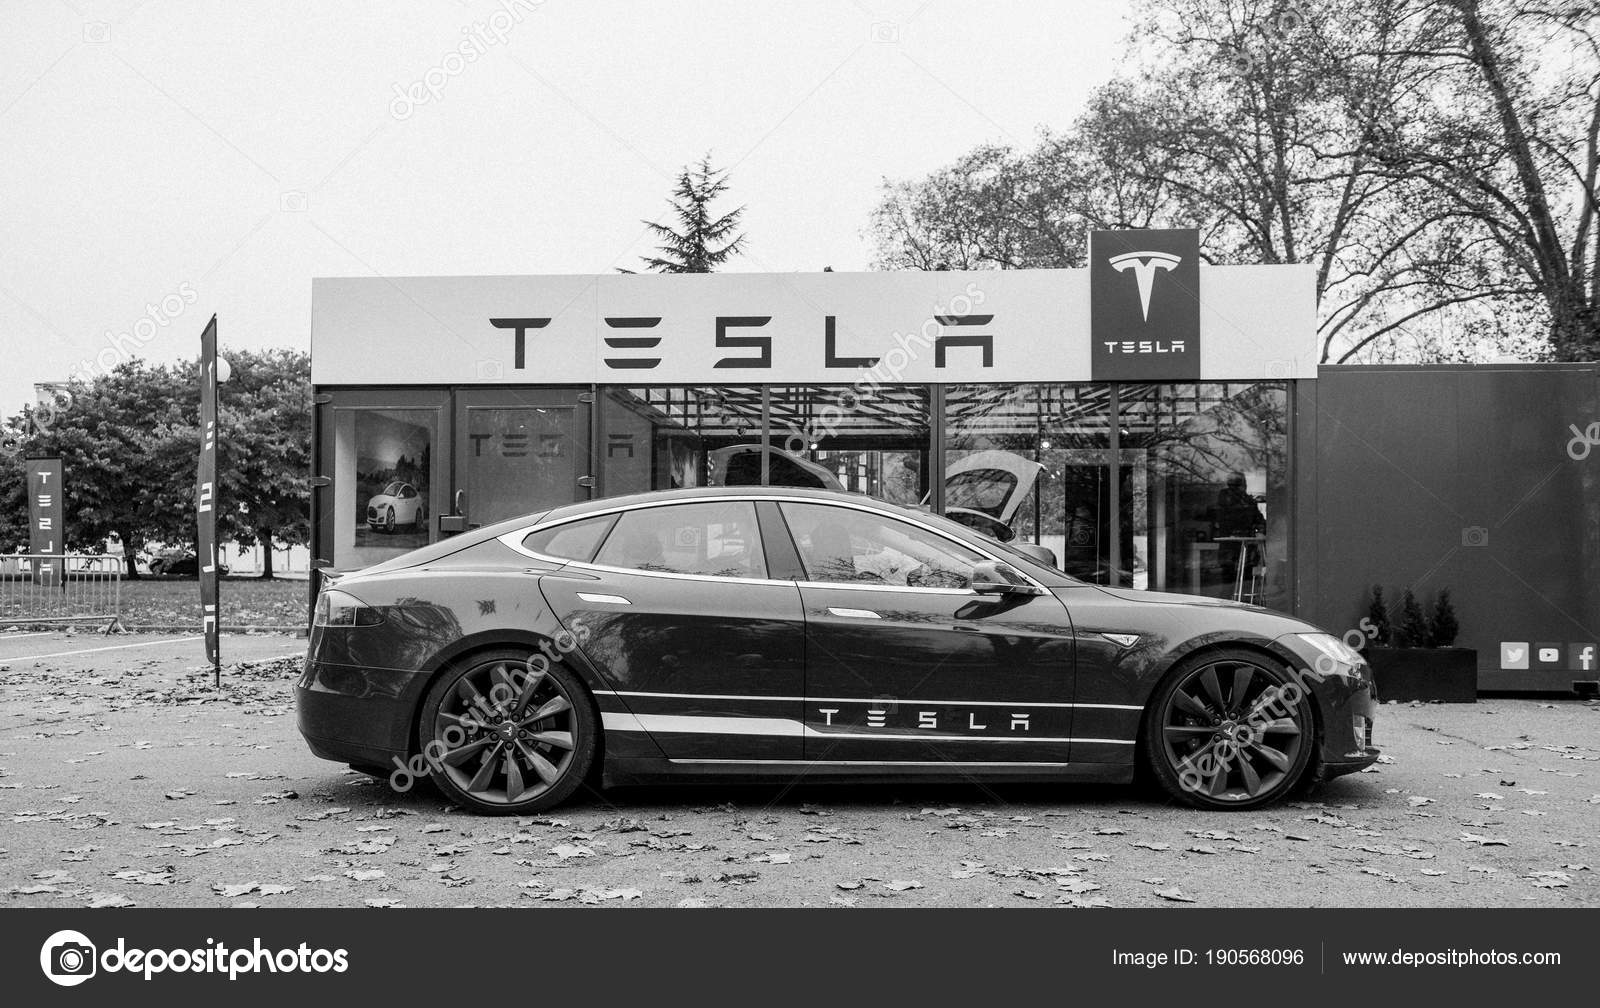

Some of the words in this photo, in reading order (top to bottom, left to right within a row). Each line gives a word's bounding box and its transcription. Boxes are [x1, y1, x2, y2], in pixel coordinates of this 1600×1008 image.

[489, 314, 994, 370] TESLA
[1104, 340, 1185, 354] TESLA
[469, 434, 634, 457] TESA
[818, 708, 1030, 731] TESLA
